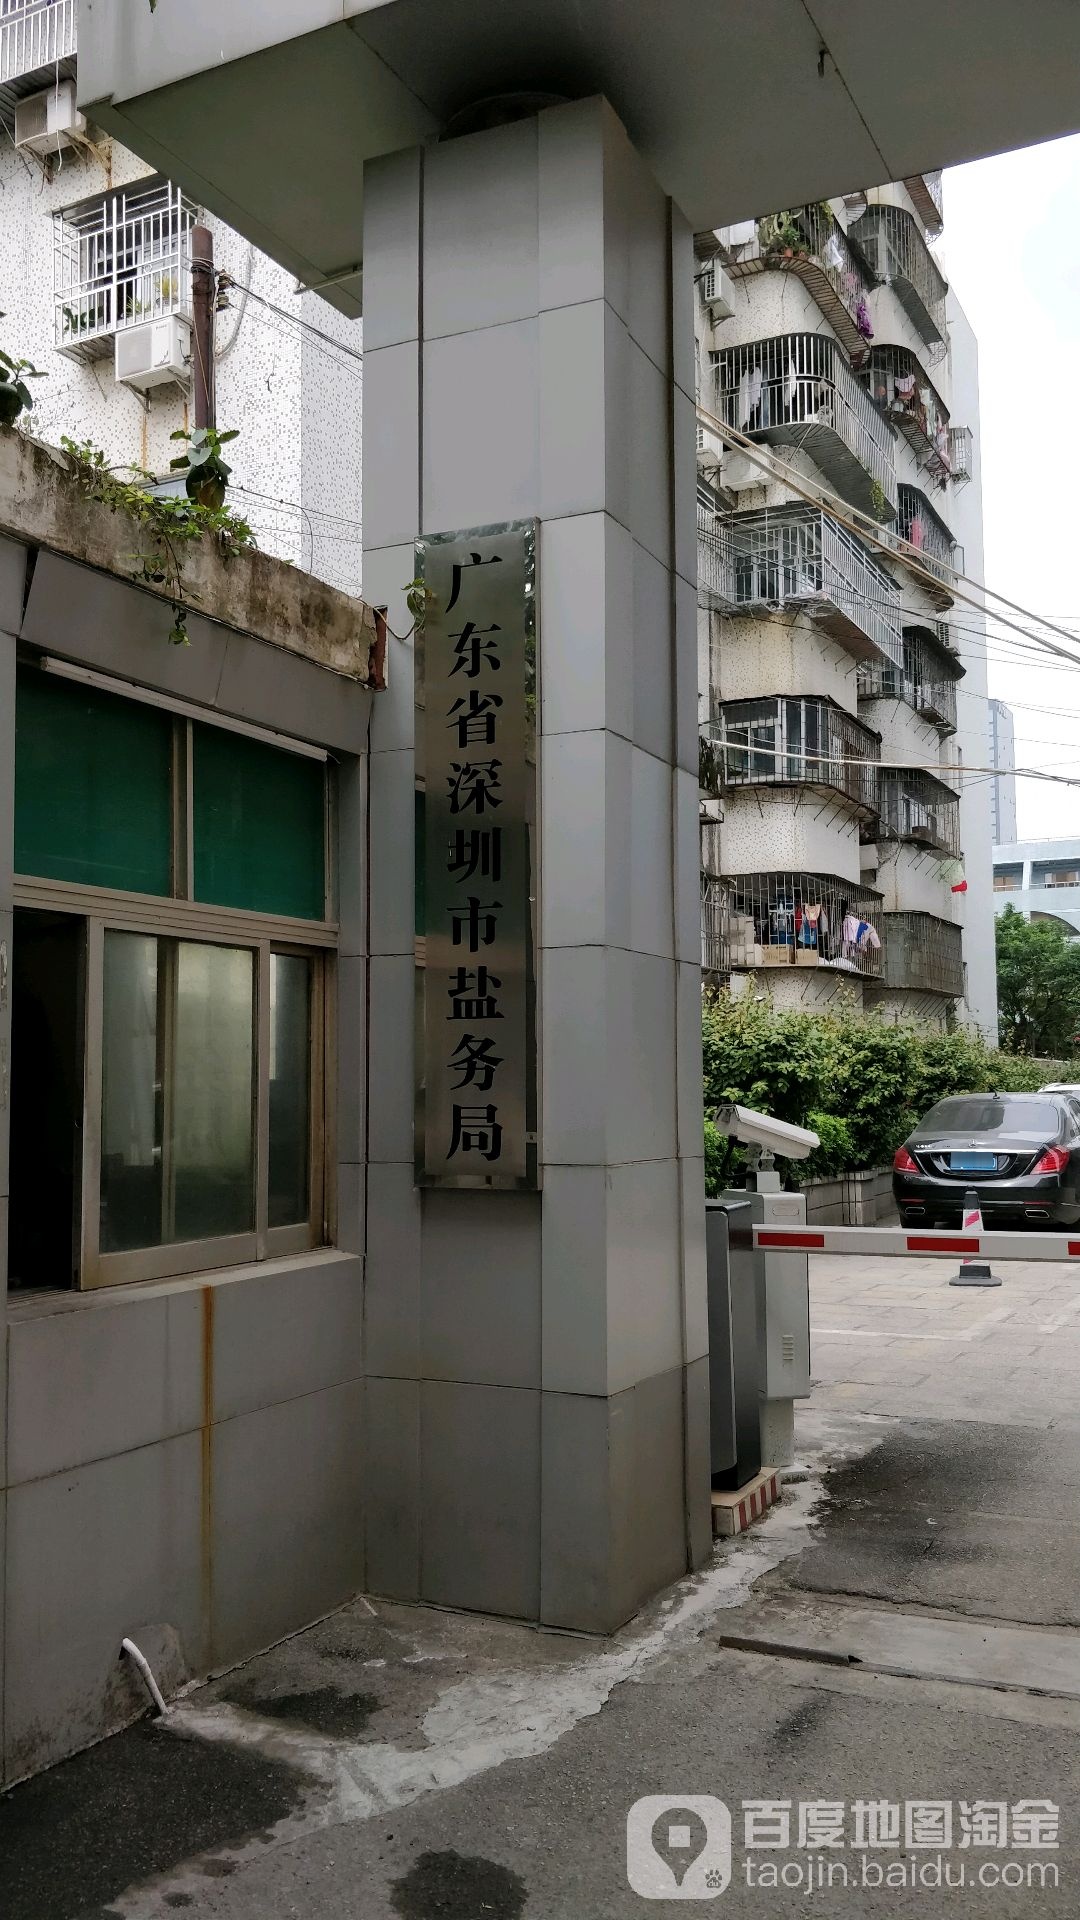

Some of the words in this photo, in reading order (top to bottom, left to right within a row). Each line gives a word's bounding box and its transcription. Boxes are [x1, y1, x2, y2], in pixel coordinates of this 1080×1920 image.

[446, 552, 503, 1161] 广东省深圳市盐务局
